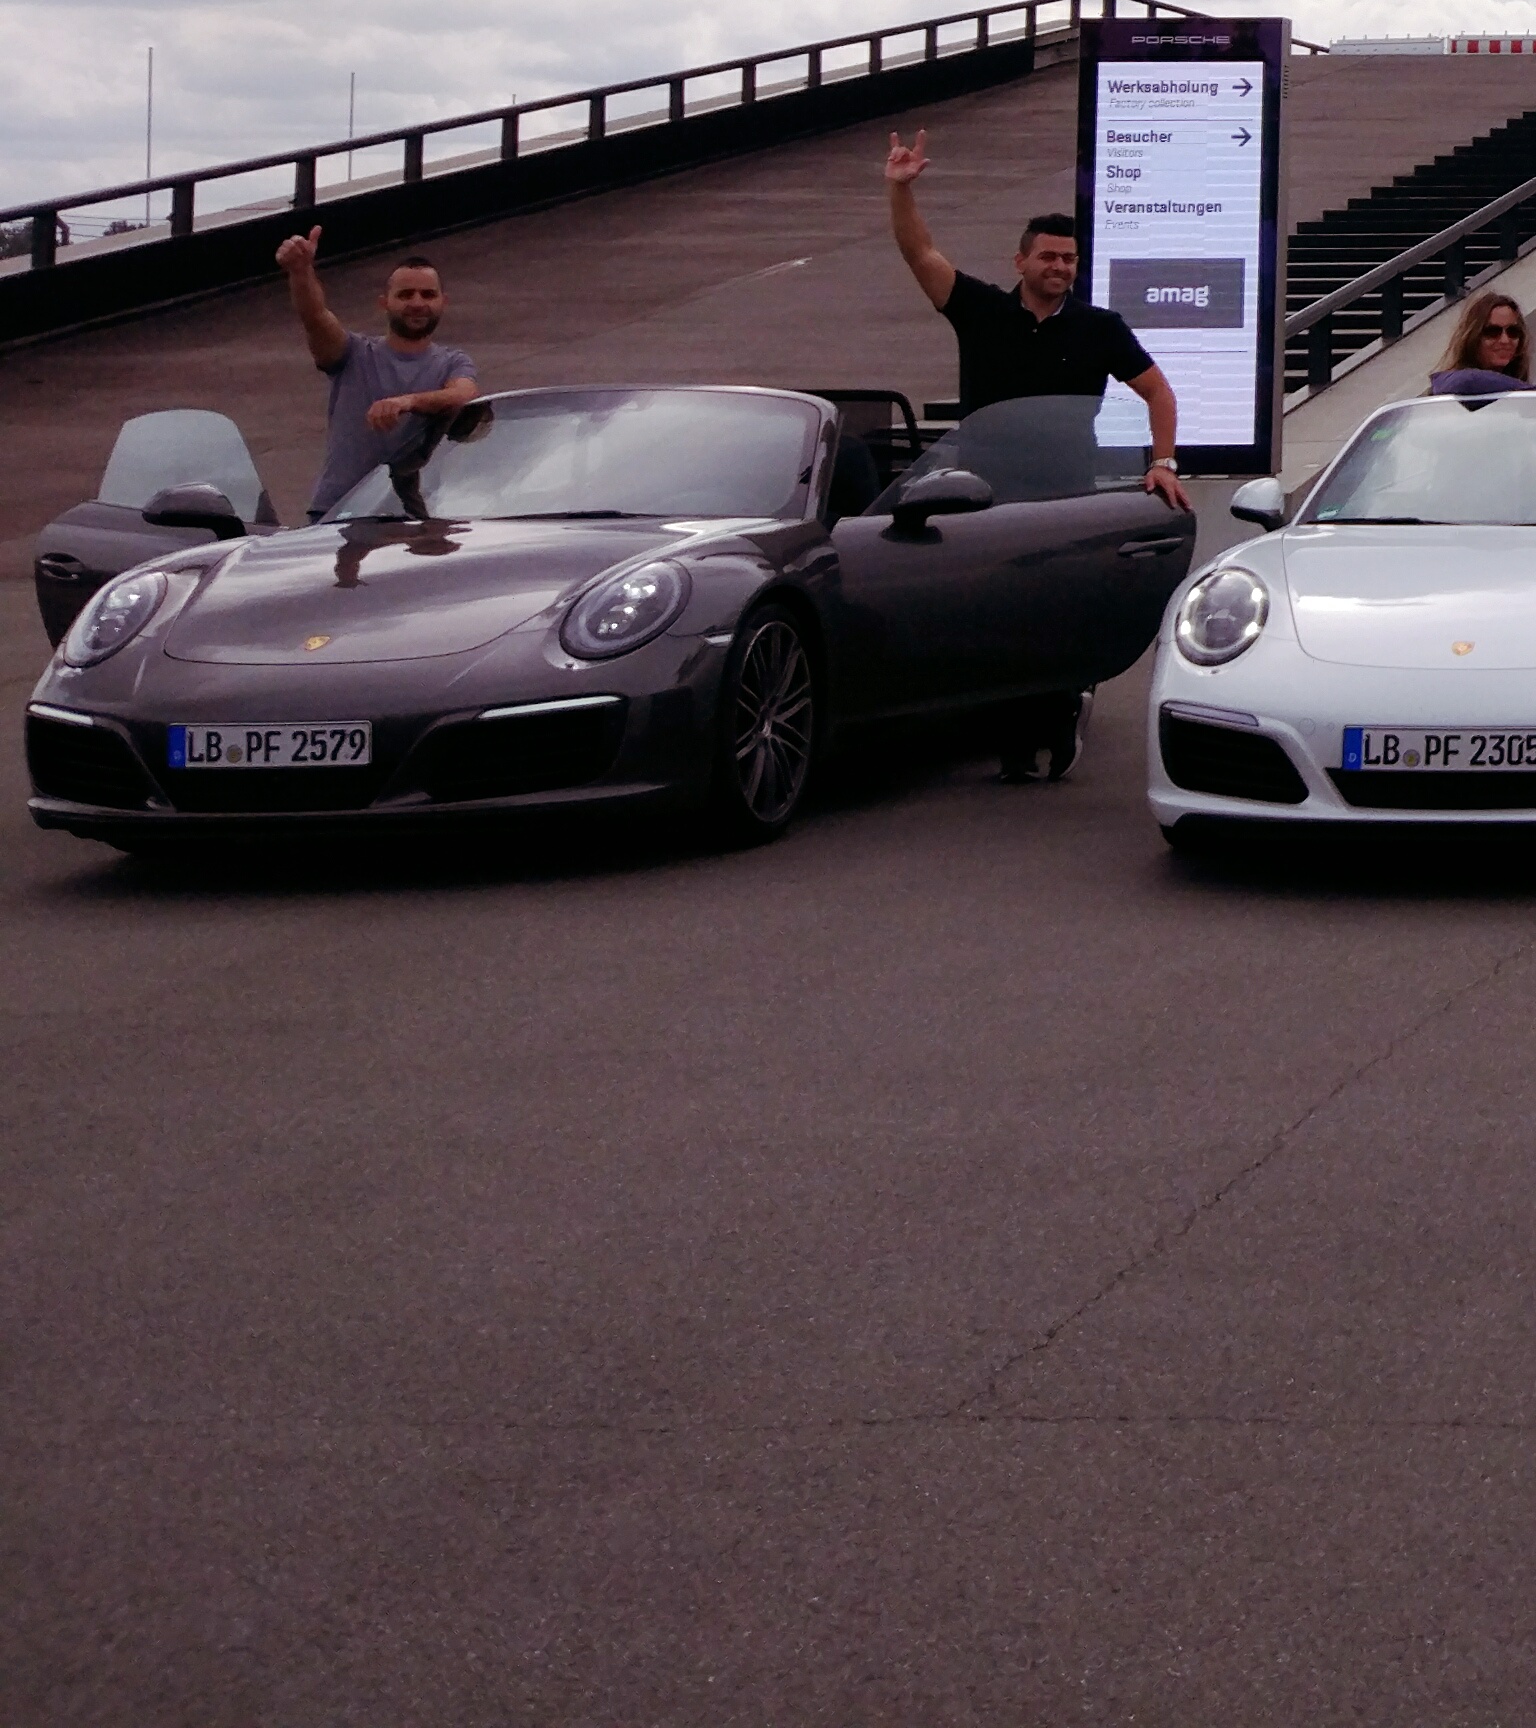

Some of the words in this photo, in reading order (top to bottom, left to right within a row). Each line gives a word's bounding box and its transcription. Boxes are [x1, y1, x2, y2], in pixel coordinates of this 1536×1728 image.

[1131, 35, 1231, 44] PORSCHE
[1107, 80, 1219, 96] Werksabholung
[1108, 98, 1147, 110] Factory
[1148, 98, 1195, 109] collection
[1106, 130, 1173, 143] Besucher
[1107, 148, 1144, 158] Visitors
[1105, 165, 1142, 181] Shop
[1106, 184, 1132, 194] Shop
[1104, 200, 1222, 216] Veranstaltungen
[1104, 220, 1140, 230] Events
[1146, 285, 1210, 307] amag
[187, 731, 222, 763] LB
[246, 731, 281, 762] PF
[291, 729, 366, 761] 2579
[1363, 733, 1400, 765] LB
[1424, 734, 1461, 766] PF
